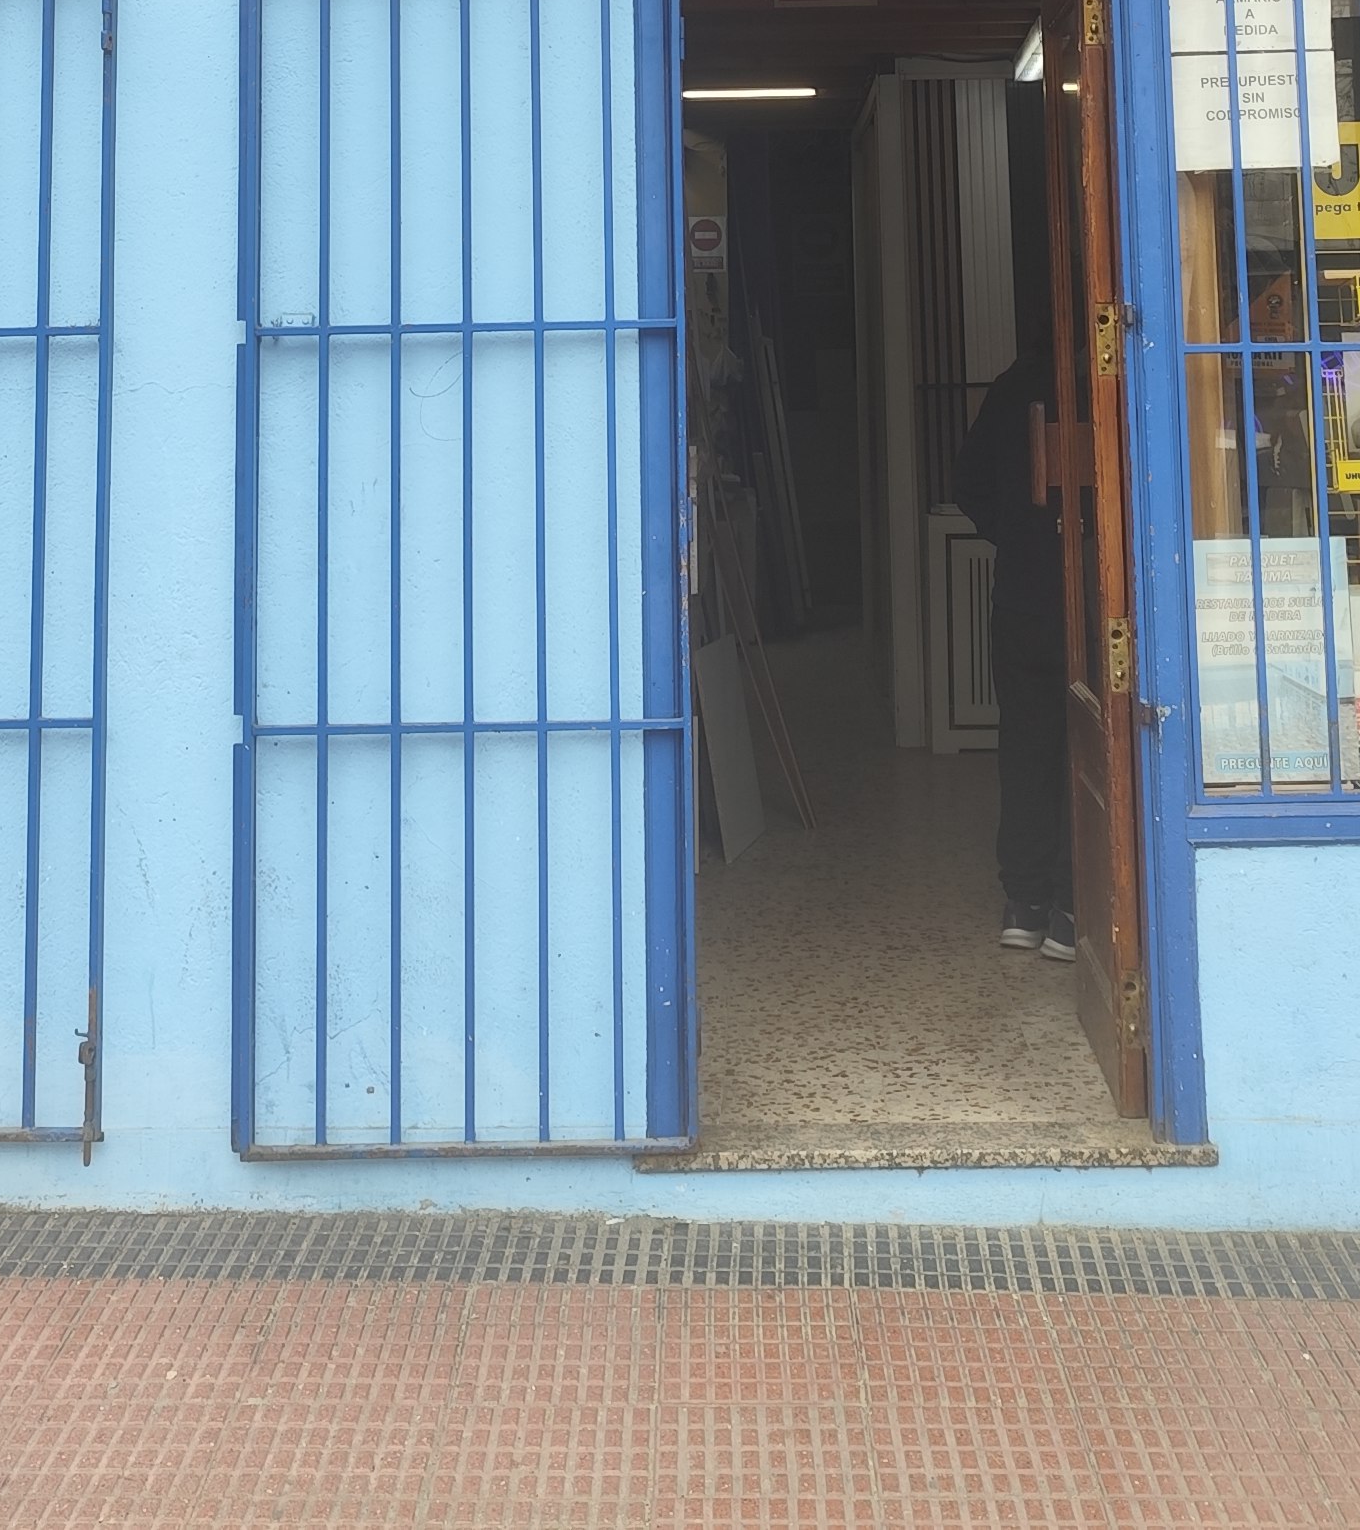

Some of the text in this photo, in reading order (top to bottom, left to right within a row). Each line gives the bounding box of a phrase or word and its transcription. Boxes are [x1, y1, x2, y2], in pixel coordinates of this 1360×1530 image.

[1245, 9, 1255, 19] A
[1224, 24, 1279, 36] EDIDA
[1201, 74, 1299, 88] PREUPUEST
[1242, 92, 1265, 103] SIN
[1315, 203, 1352, 215] pega
[1229, 553, 1297, 568] PAQUET
[1234, 571, 1292, 583] TAIMA
[1287, 596, 1323, 608] SUEL
[1228, 611, 1247, 621] DE
[1264, 629, 1324, 641] ARNIZAD
